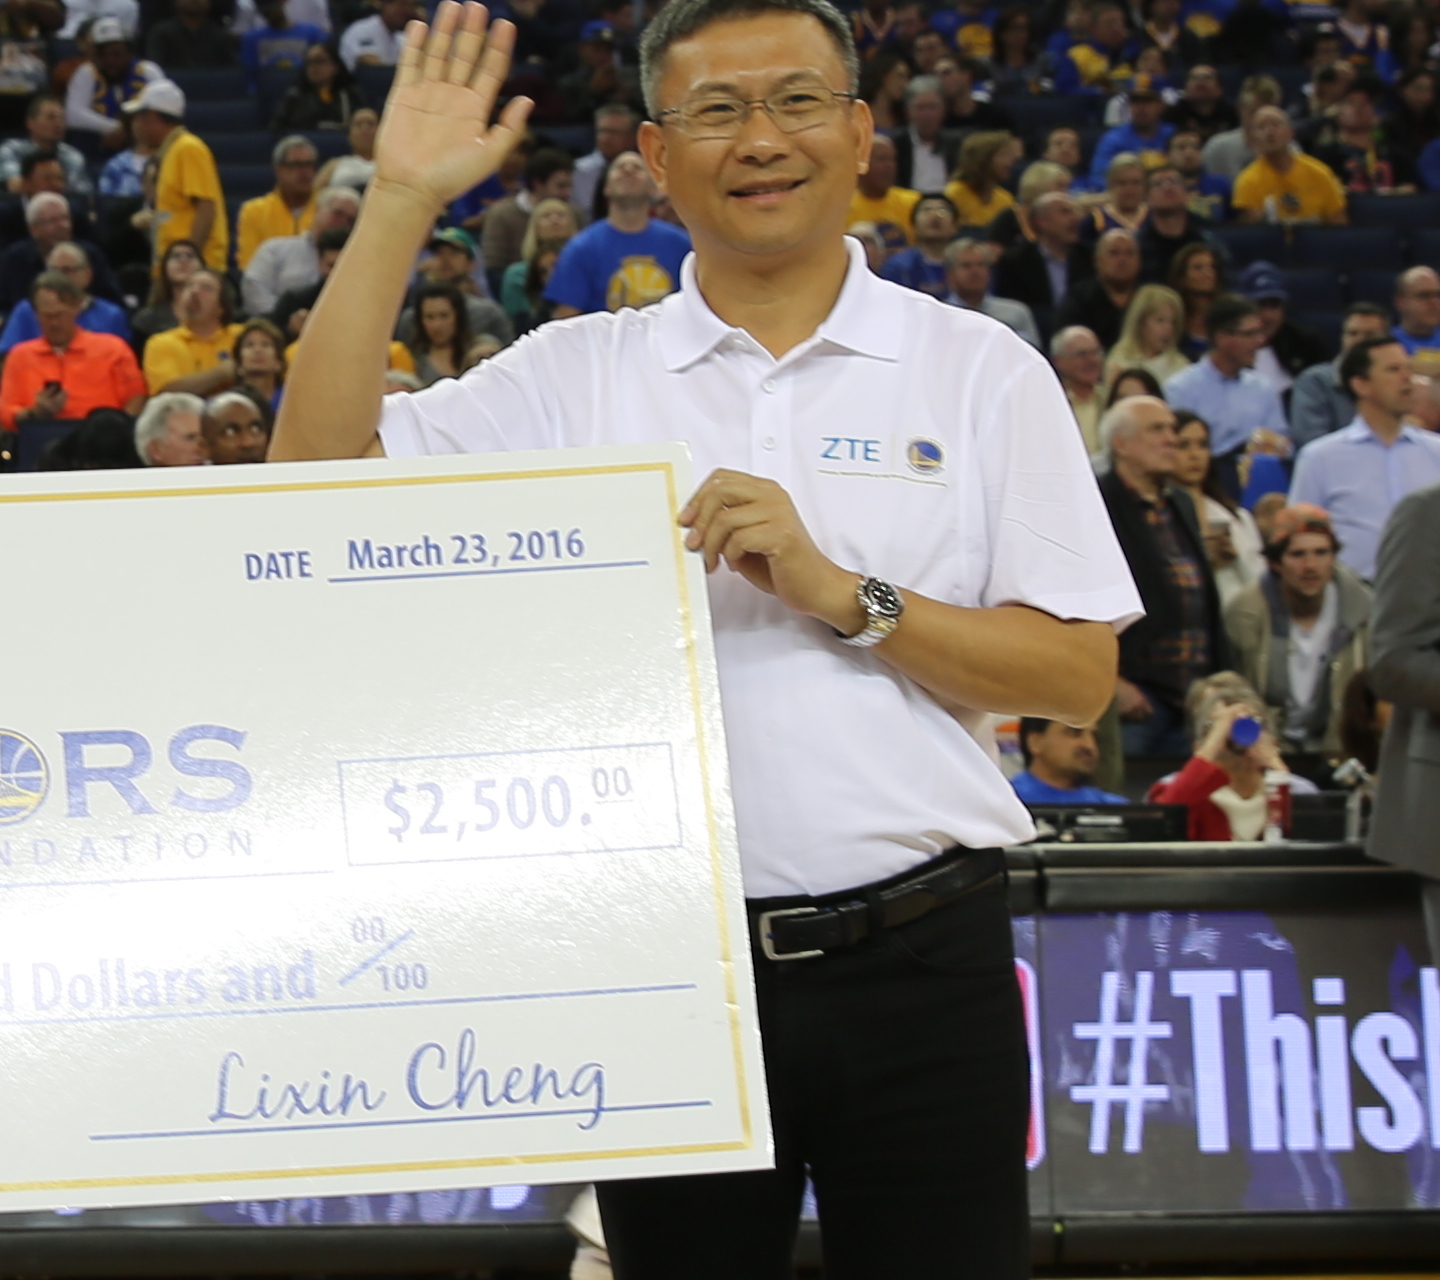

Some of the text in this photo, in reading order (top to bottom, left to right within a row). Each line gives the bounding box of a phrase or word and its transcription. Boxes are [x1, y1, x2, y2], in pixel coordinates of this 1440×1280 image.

[820, 437, 881, 462] ZTE
[245, 529, 584, 580] DATE March 23, 2016
[32, 958, 206, 1010] Dollars
[220, 950, 317, 1002] and
[209, 1028, 604, 1130] Lixin Cheng
